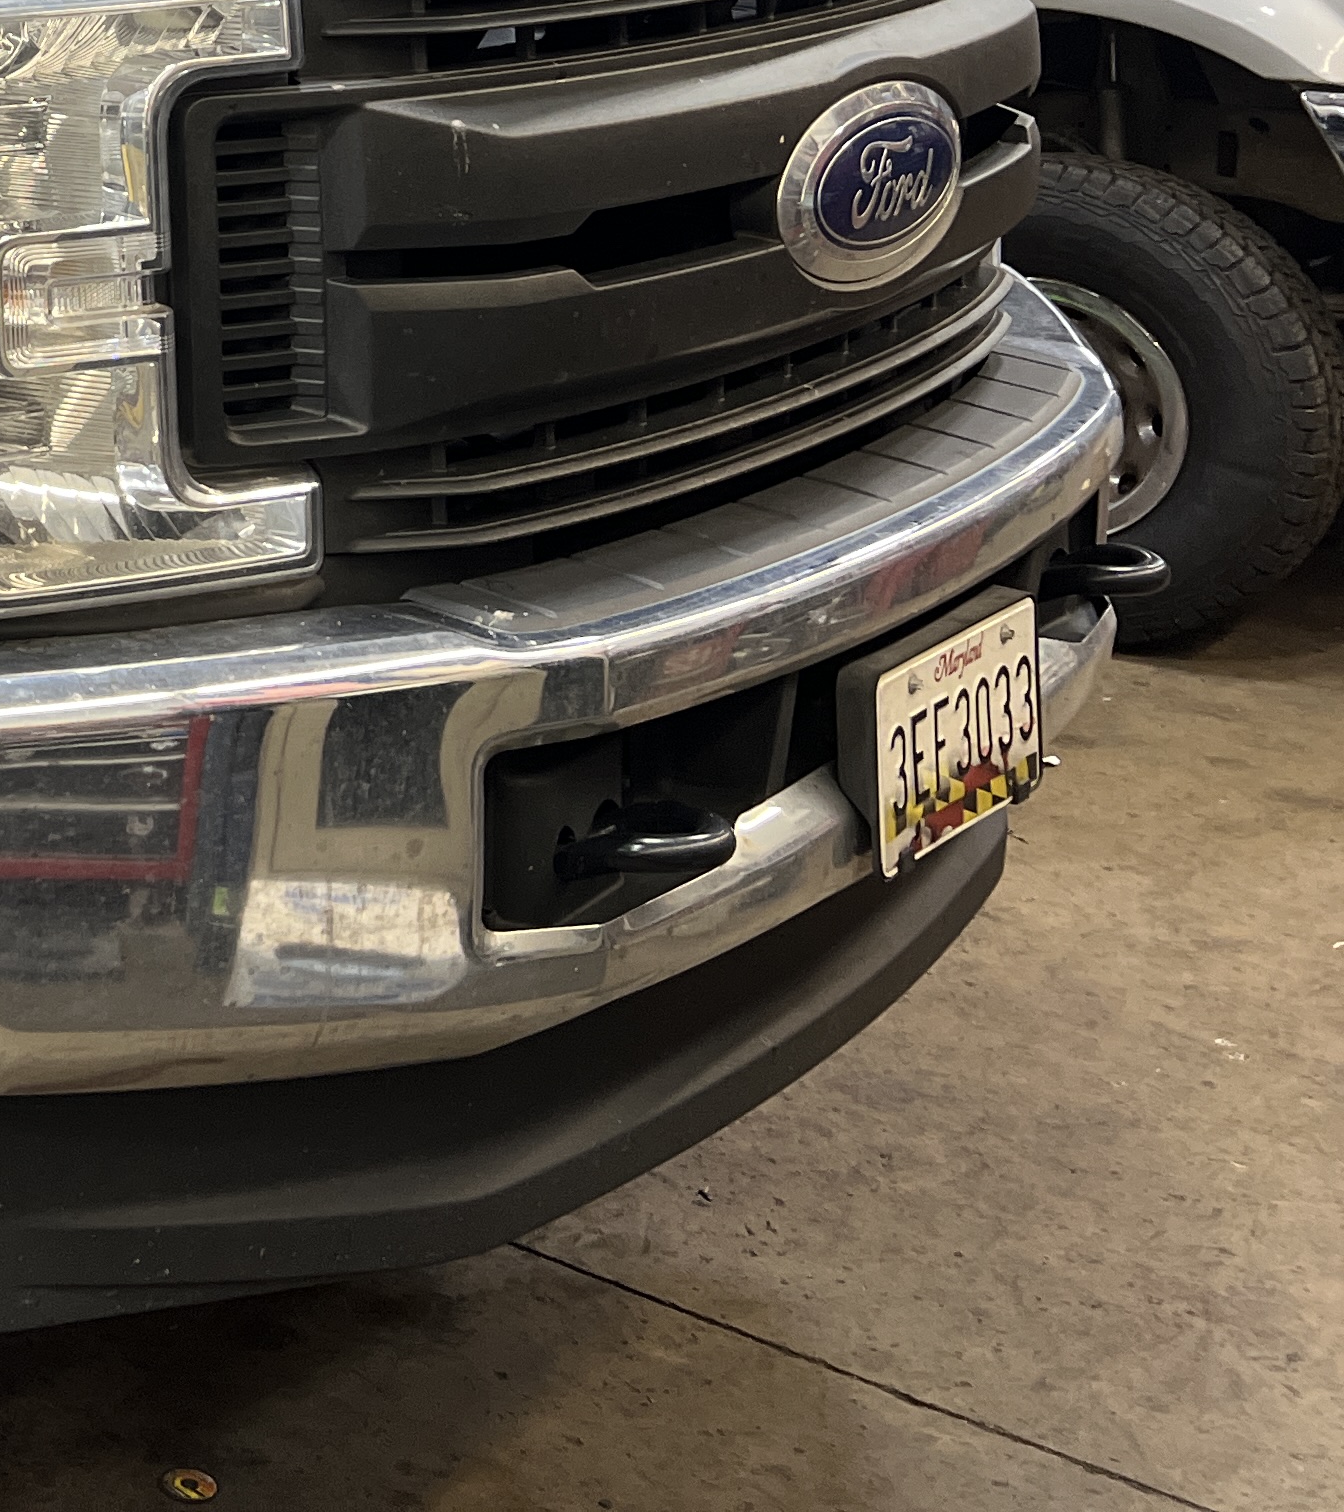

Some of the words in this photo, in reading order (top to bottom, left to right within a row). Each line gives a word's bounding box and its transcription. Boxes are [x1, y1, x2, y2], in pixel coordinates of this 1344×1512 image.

[851, 134, 934, 230] Ford
[934, 631, 985, 683] Maryland
[890, 654, 1034, 811] 3EF3033
